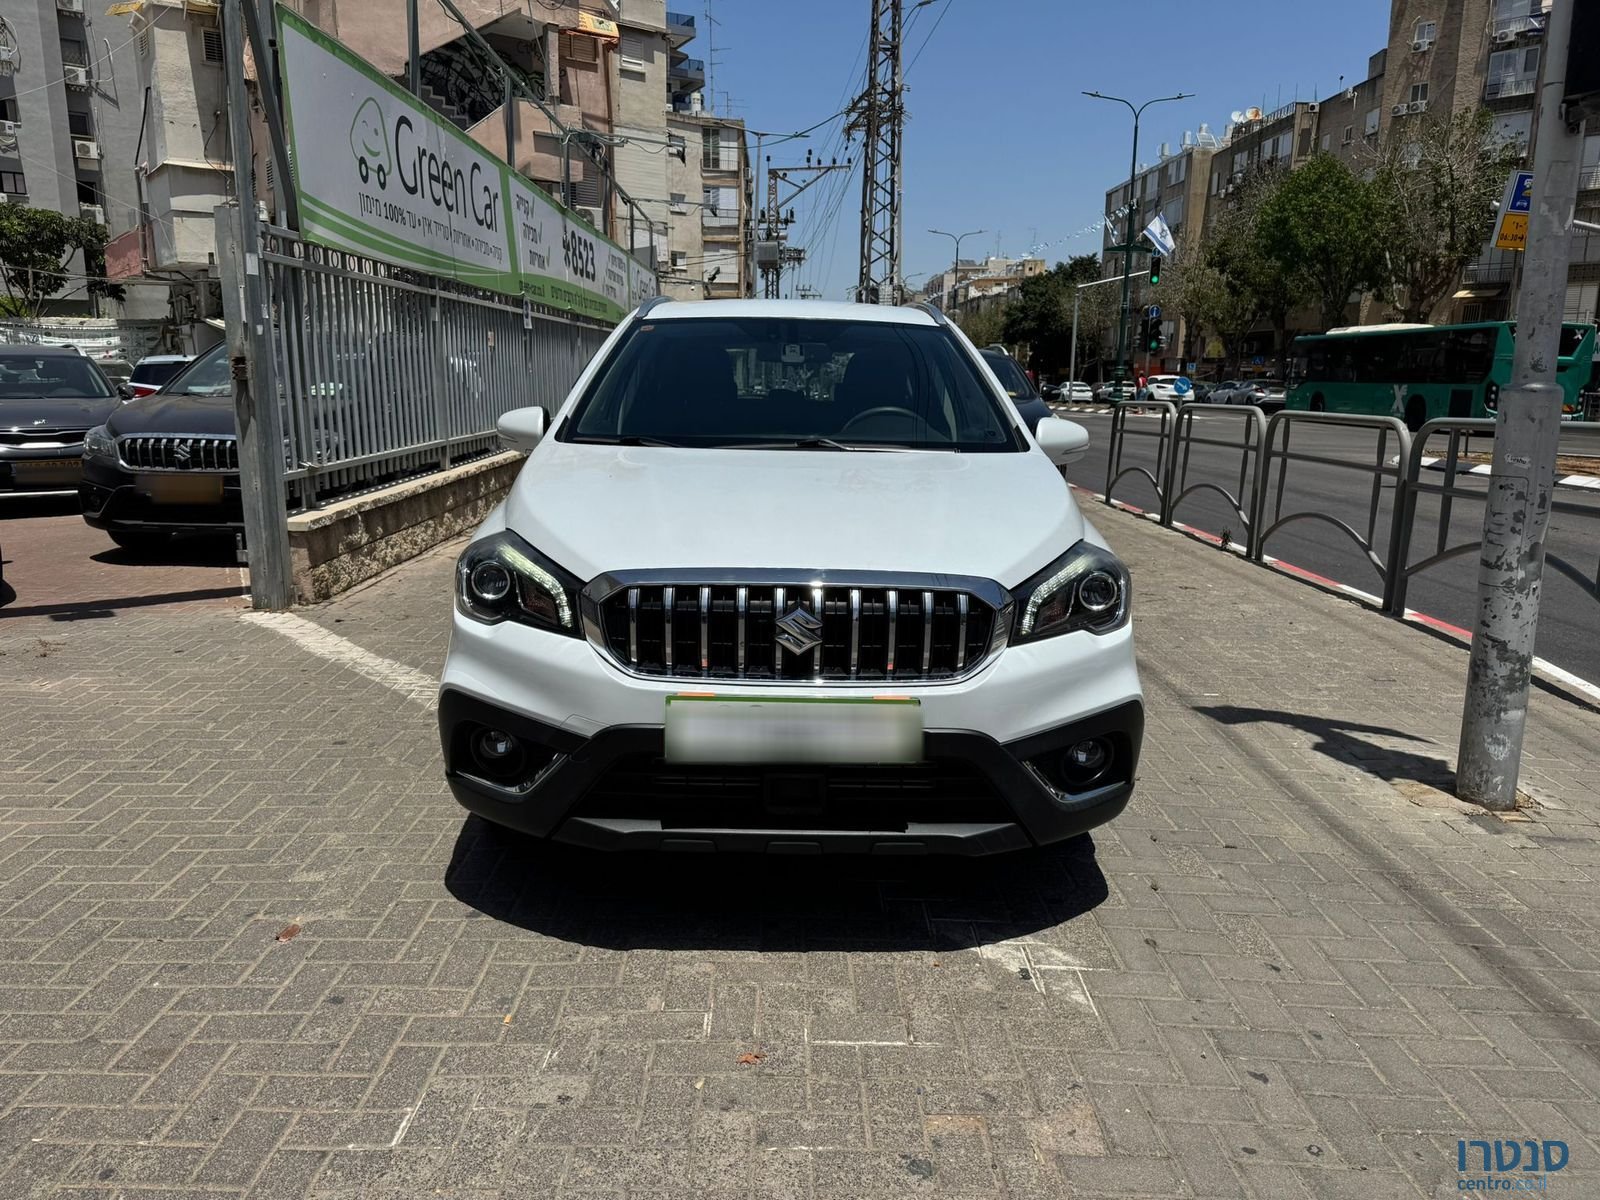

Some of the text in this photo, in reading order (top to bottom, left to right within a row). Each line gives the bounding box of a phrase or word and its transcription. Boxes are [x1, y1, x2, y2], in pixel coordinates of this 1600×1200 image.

[395, 115, 498, 233] Green Car
[358, 192, 382, 217] מימון
[383, 202, 407, 226] 100%
[406, 210, 417, 229] עד
[422, 216, 433, 237] אין
